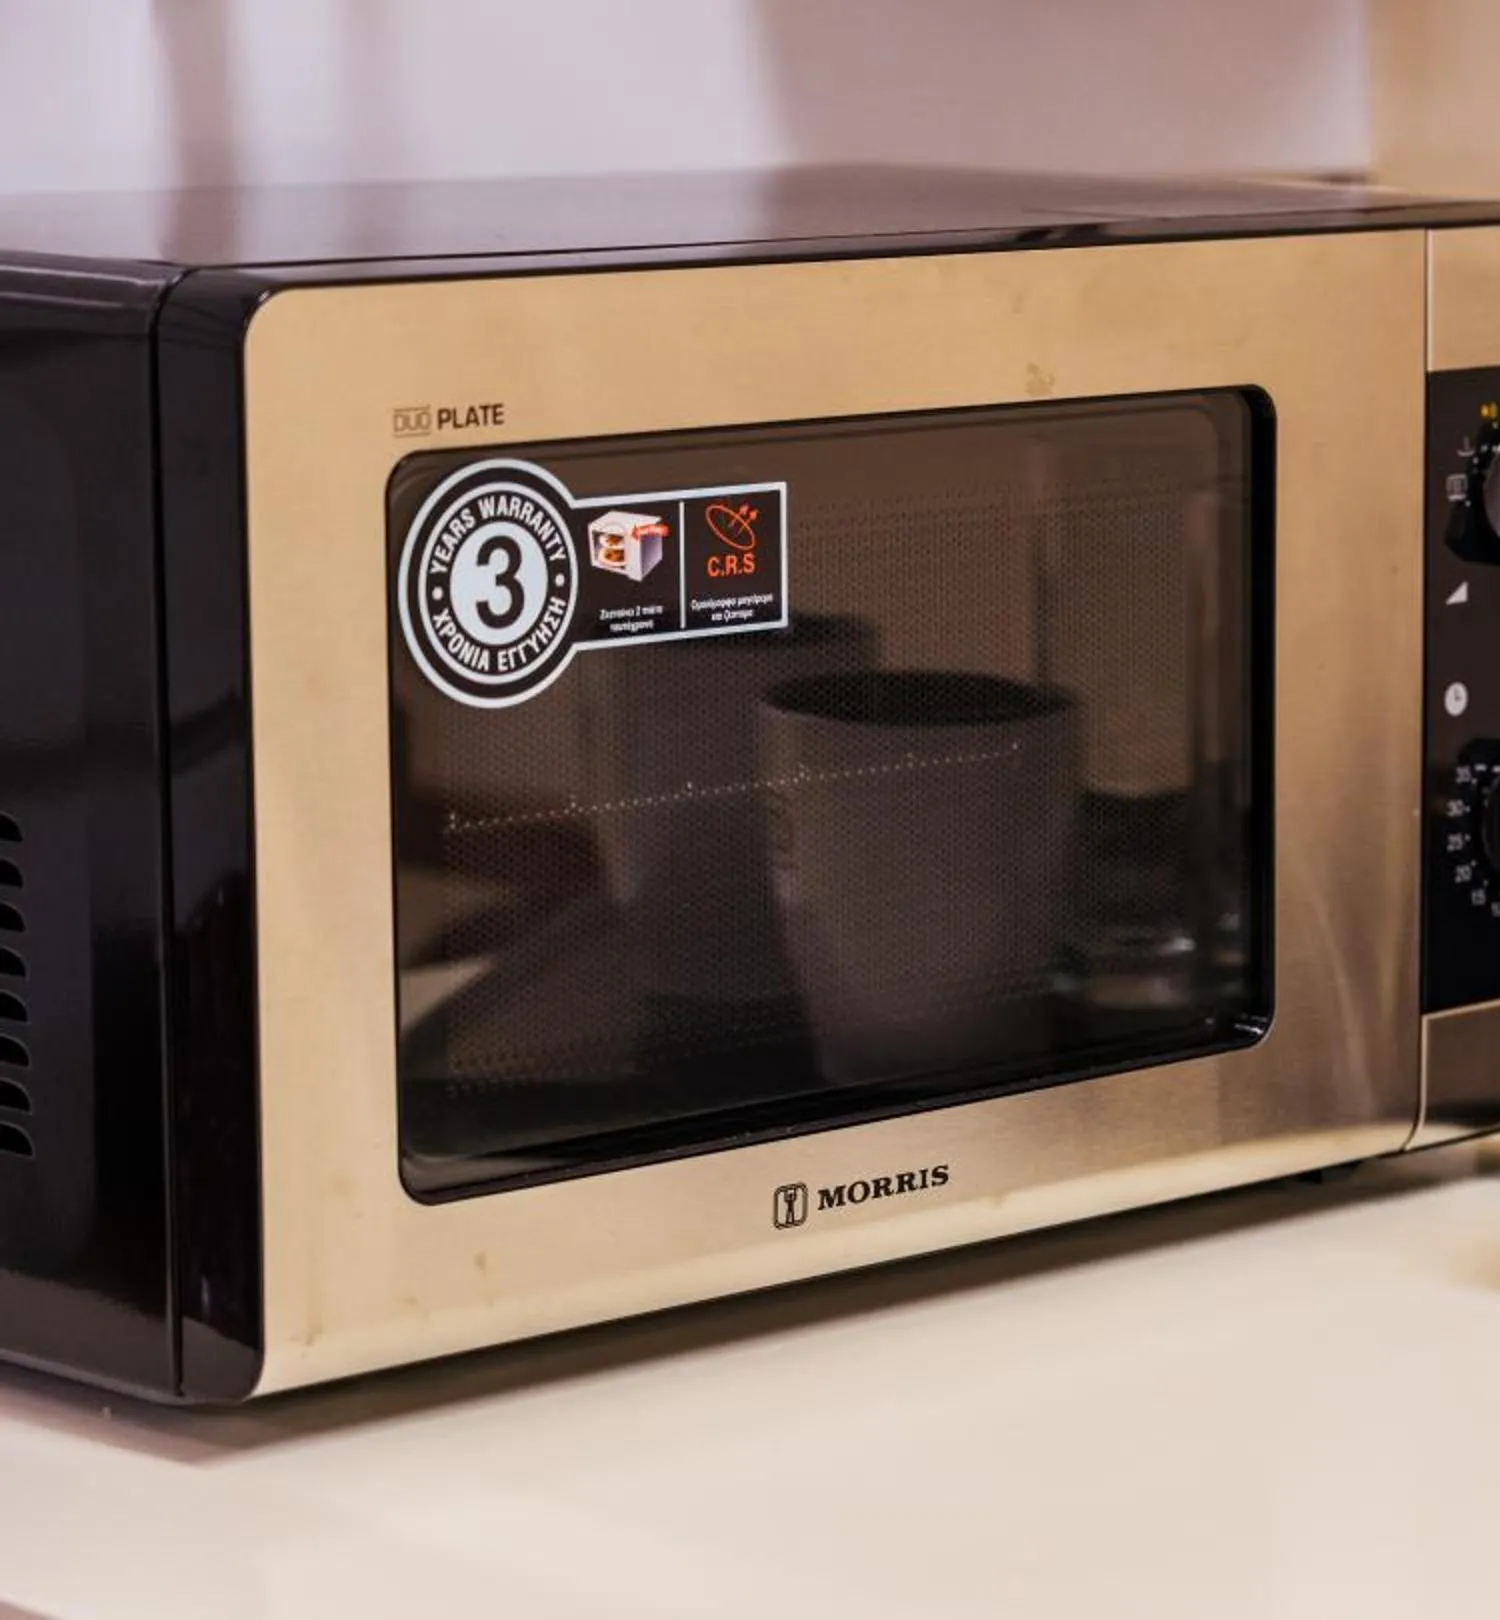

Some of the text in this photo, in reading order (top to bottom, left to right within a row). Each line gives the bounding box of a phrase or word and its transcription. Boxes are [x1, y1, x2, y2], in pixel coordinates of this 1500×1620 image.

[437, 402, 504, 431] PLATE
[429, 494, 567, 574] YEARS WARRANTY
[475, 534, 526, 630] 3
[706, 552, 756, 578] C.R.S
[817, 1163, 949, 1211] MORRIS
